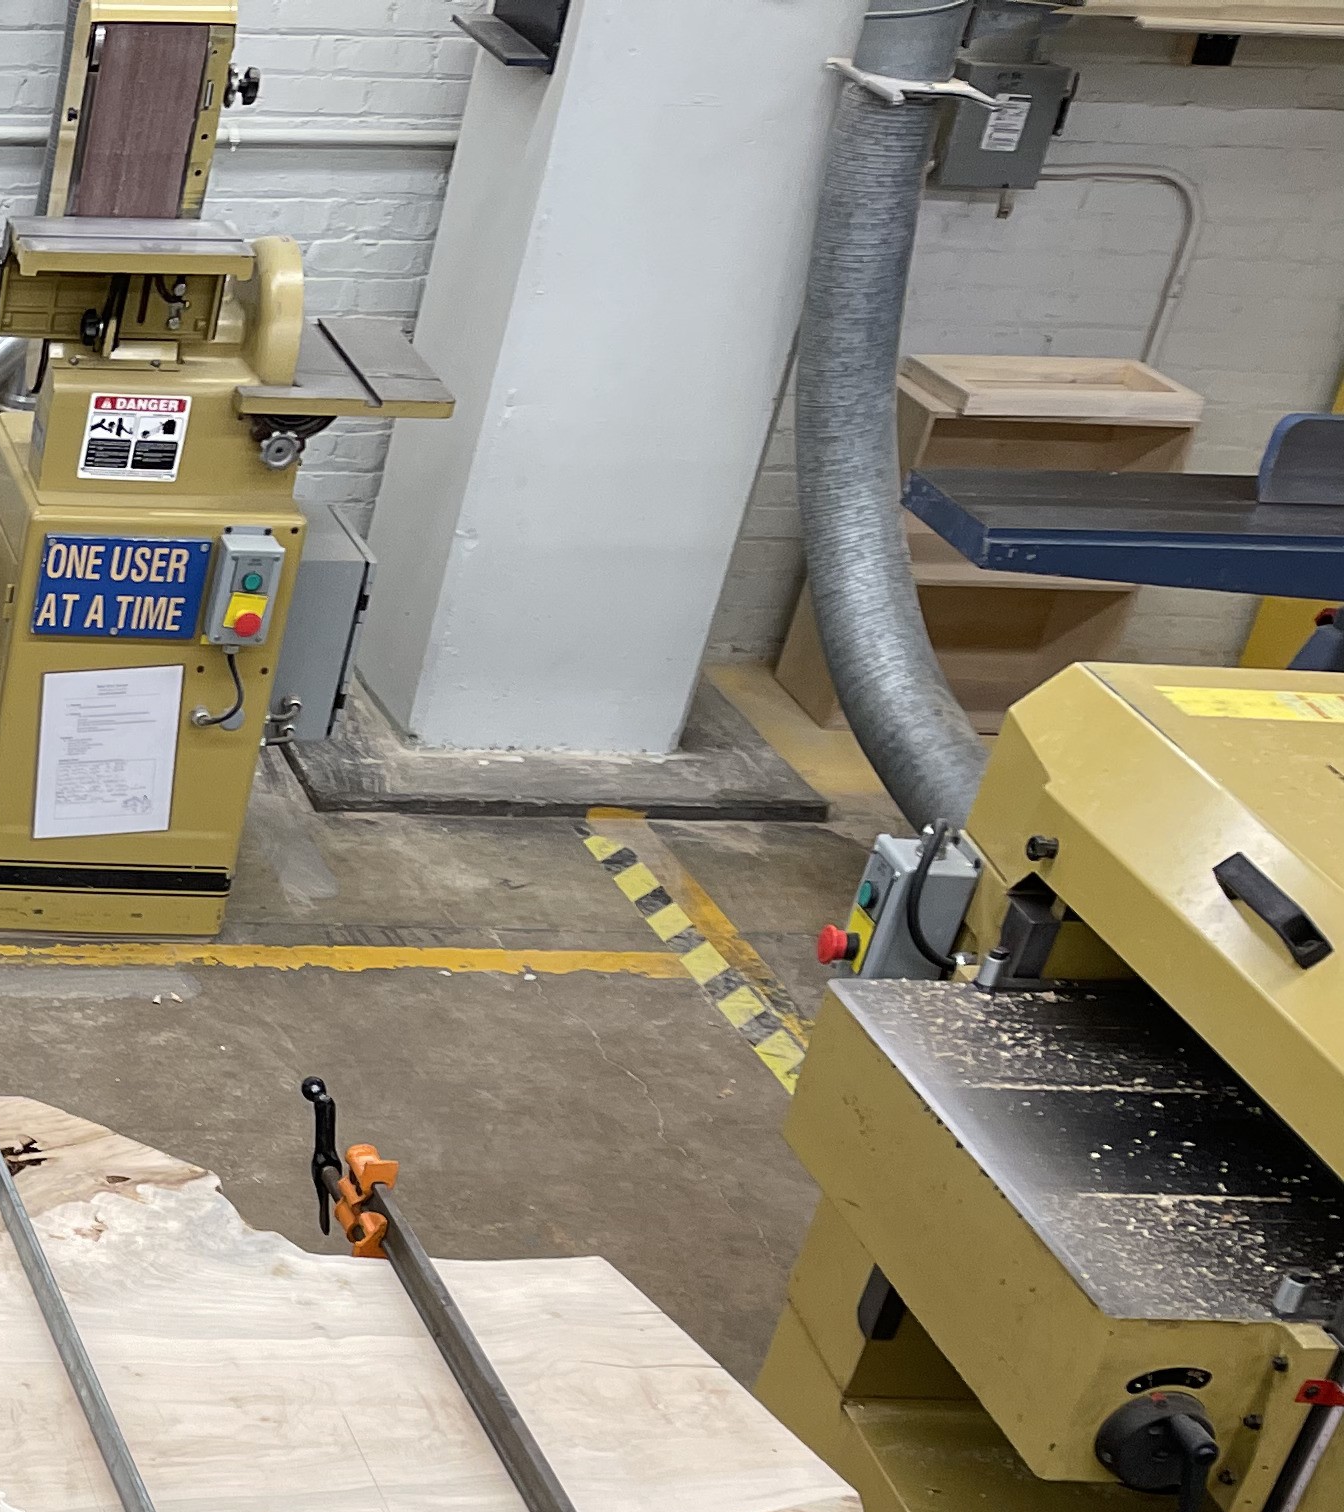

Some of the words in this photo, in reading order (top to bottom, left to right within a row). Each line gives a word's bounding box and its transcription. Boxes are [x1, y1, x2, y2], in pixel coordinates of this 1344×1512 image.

[115, 397, 180, 412] DANGER
[46, 543, 106, 580] ONE
[110, 546, 190, 583] USER
[36, 592, 81, 628] AT
[83, 594, 105, 629] A
[116, 595, 186, 631] TIME
